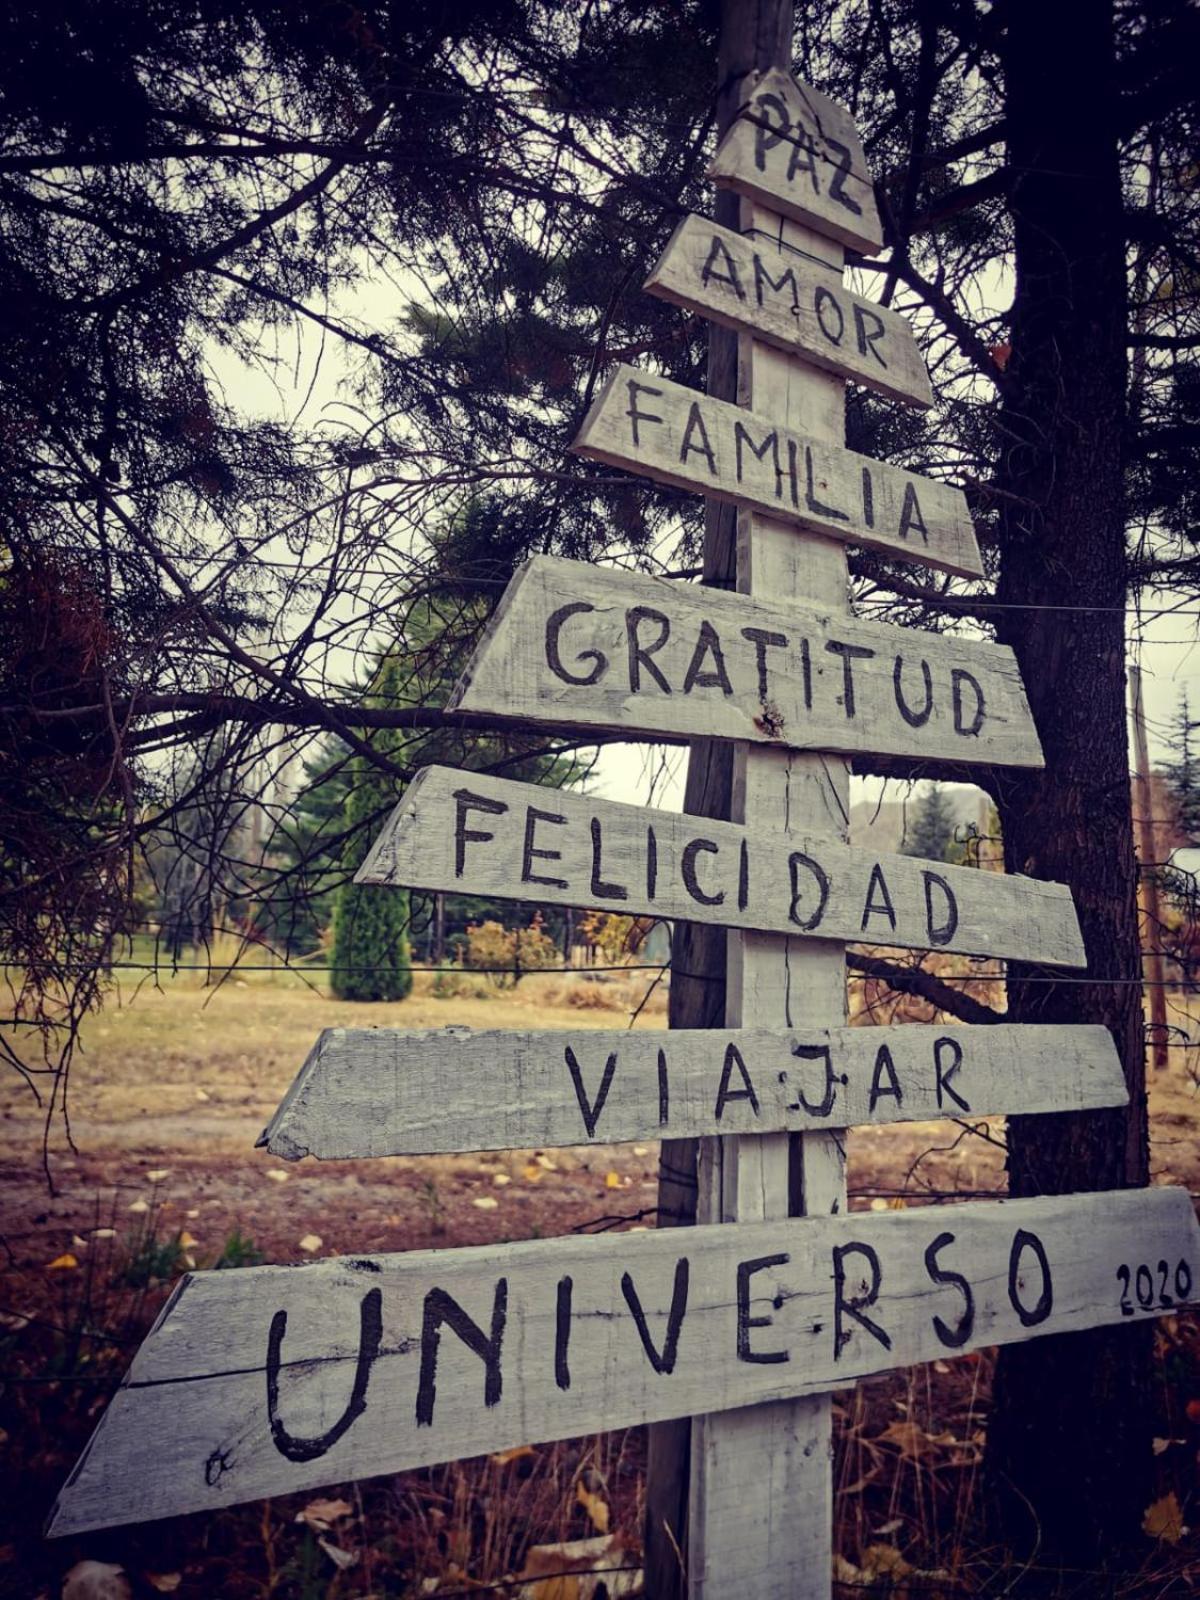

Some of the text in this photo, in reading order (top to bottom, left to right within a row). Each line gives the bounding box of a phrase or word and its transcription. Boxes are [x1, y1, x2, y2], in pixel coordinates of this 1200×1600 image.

[754, 93, 862, 216] PAZ
[701, 236, 888, 369] AMOR
[626, 379, 928, 547] FAMILIA
[545, 602, 985, 737] GRATITUD
[453, 788, 959, 946] FELICIDAD
[565, 1036, 971, 1138] VIAJAR
[266, 1228, 1192, 1463] UNIVERSO 2020
